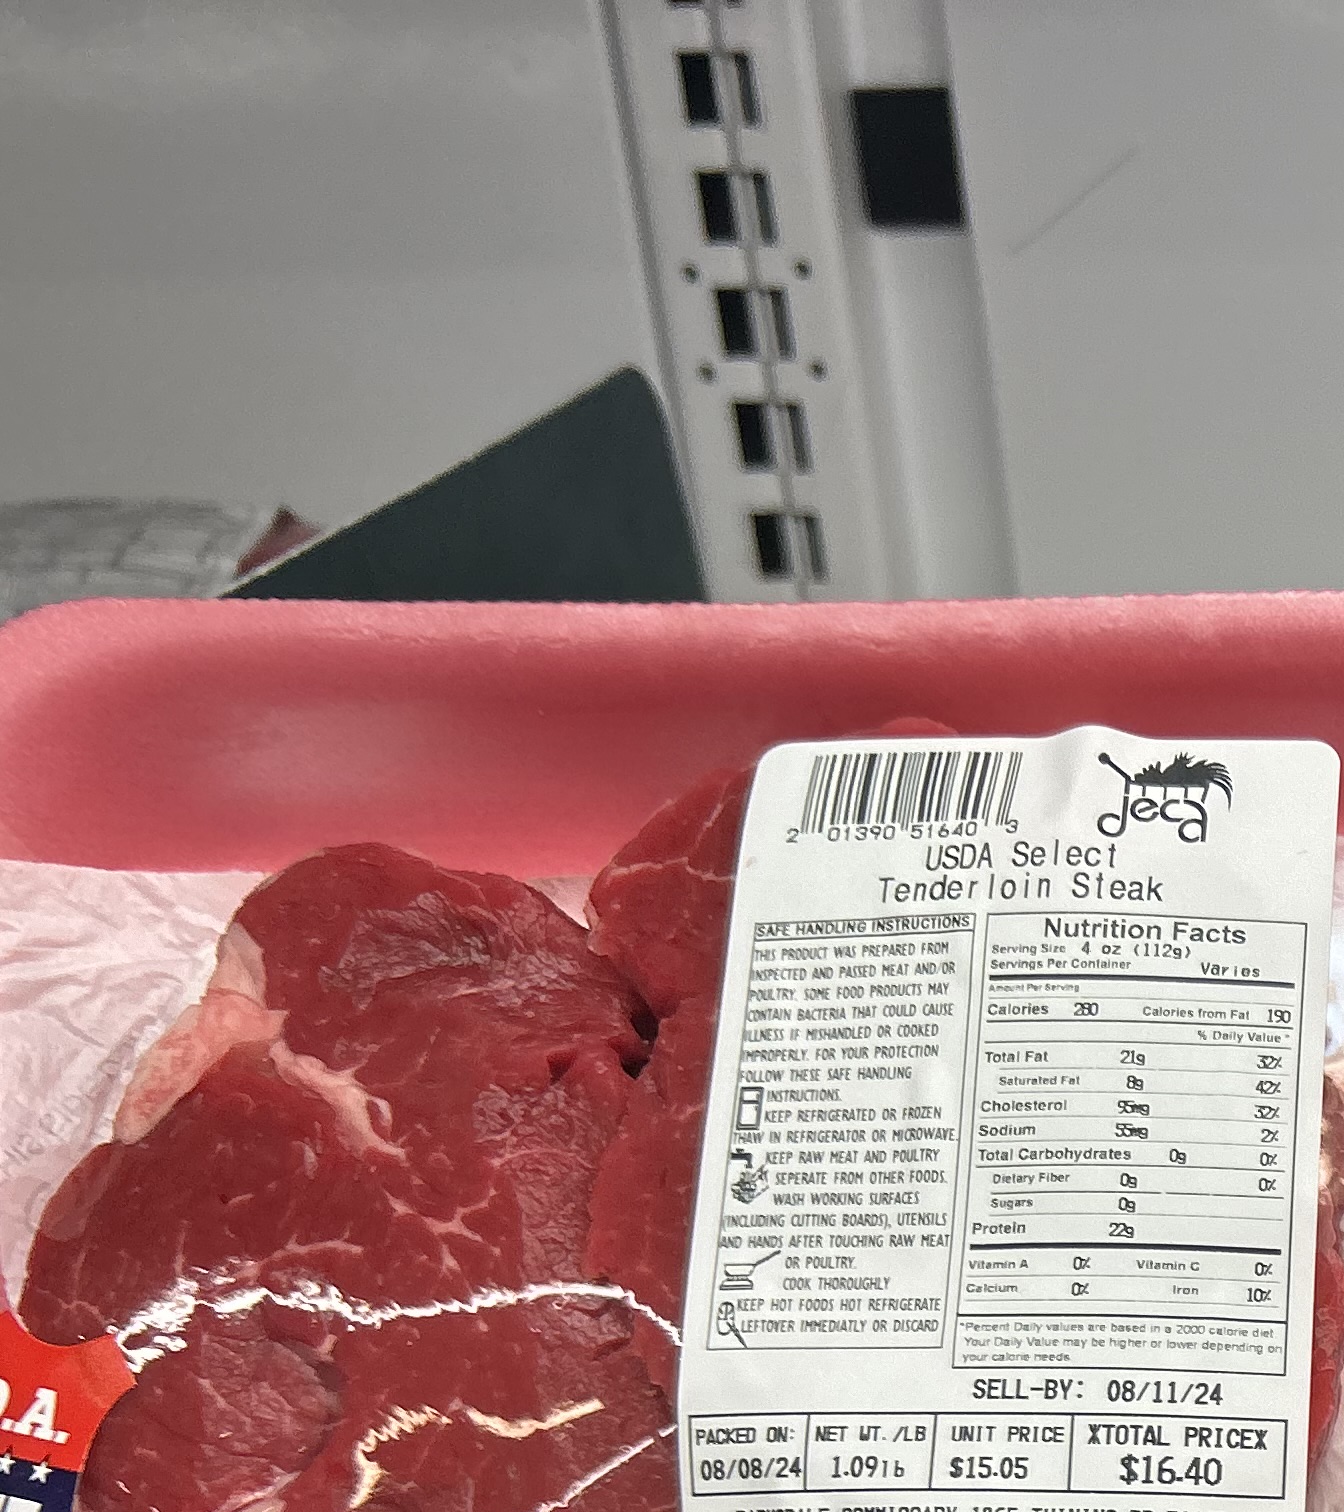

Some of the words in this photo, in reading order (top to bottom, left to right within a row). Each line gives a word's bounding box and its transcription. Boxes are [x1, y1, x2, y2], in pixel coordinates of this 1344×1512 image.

[786, 828, 799, 843] 2
[828, 825, 895, 842] 01390
[911, 818, 977, 839] 51640
[1004, 816, 1018, 833] 3
[926, 843, 992, 871] USDA
[1012, 839, 1116, 868] Select
[879, 872, 1050, 903] Tenderloin
[1072, 872, 1162, 901] Steak
[756, 923, 790, 938] SAFE
[796, 920, 867, 935] HANDLING
[871, 916, 971, 933] INSTRUCTIONS
[1045, 918, 1161, 940] Nutrition
[1173, 922, 1246, 944] Facts
[992, 944, 1037, 956] Serving
[1041, 944, 1065, 953] Size
[1082, 941, 1089, 955] 4
[1102, 945, 1121, 955] oz
[1134, 943, 1191, 959] (112g)
[991, 960, 1043, 970] Servings
[1048, 959, 1067, 968] Per
[1201, 962, 1259, 977] Varies
[988, 1003, 1048, 1015] Calories
[1143, 1006, 1193, 1017] Calories
[1198, 1009, 1226, 1019] from
[1231, 1010, 1249, 1020] Fat
[985, 1051, 1019, 1063] Total
[1025, 1051, 1048, 1062] Fat
[981, 1100, 1067, 1112] Cholesterol
[979, 1125, 1035, 1136] Sodium
[978, 1149, 1013, 1161] Total
[1019, 1148, 1131, 1162] Carbohydrates
[1170, 1149, 1186, 1164] 0g
[972, 1222, 1025, 1234] Protein
[973, 1379, 1083, 1400] SELL-BY:
[1108, 1380, 1223, 1405] 08/11/24
[696, 1428, 756, 1445] PACKED
[766, 1427, 795, 1443] ON:
[815, 1426, 848, 1441] NET
[859, 1426, 886, 1441] WT.
[893, 1426, 926, 1442] /LB
[952, 1426, 997, 1442] UNIT
[1008, 1426, 1064, 1442] PRICE
[701, 1457, 801, 1481] 08/08/24
[950, 1457, 1029, 1479] $15.05
[1120, 1454, 1222, 1486] $16.40
